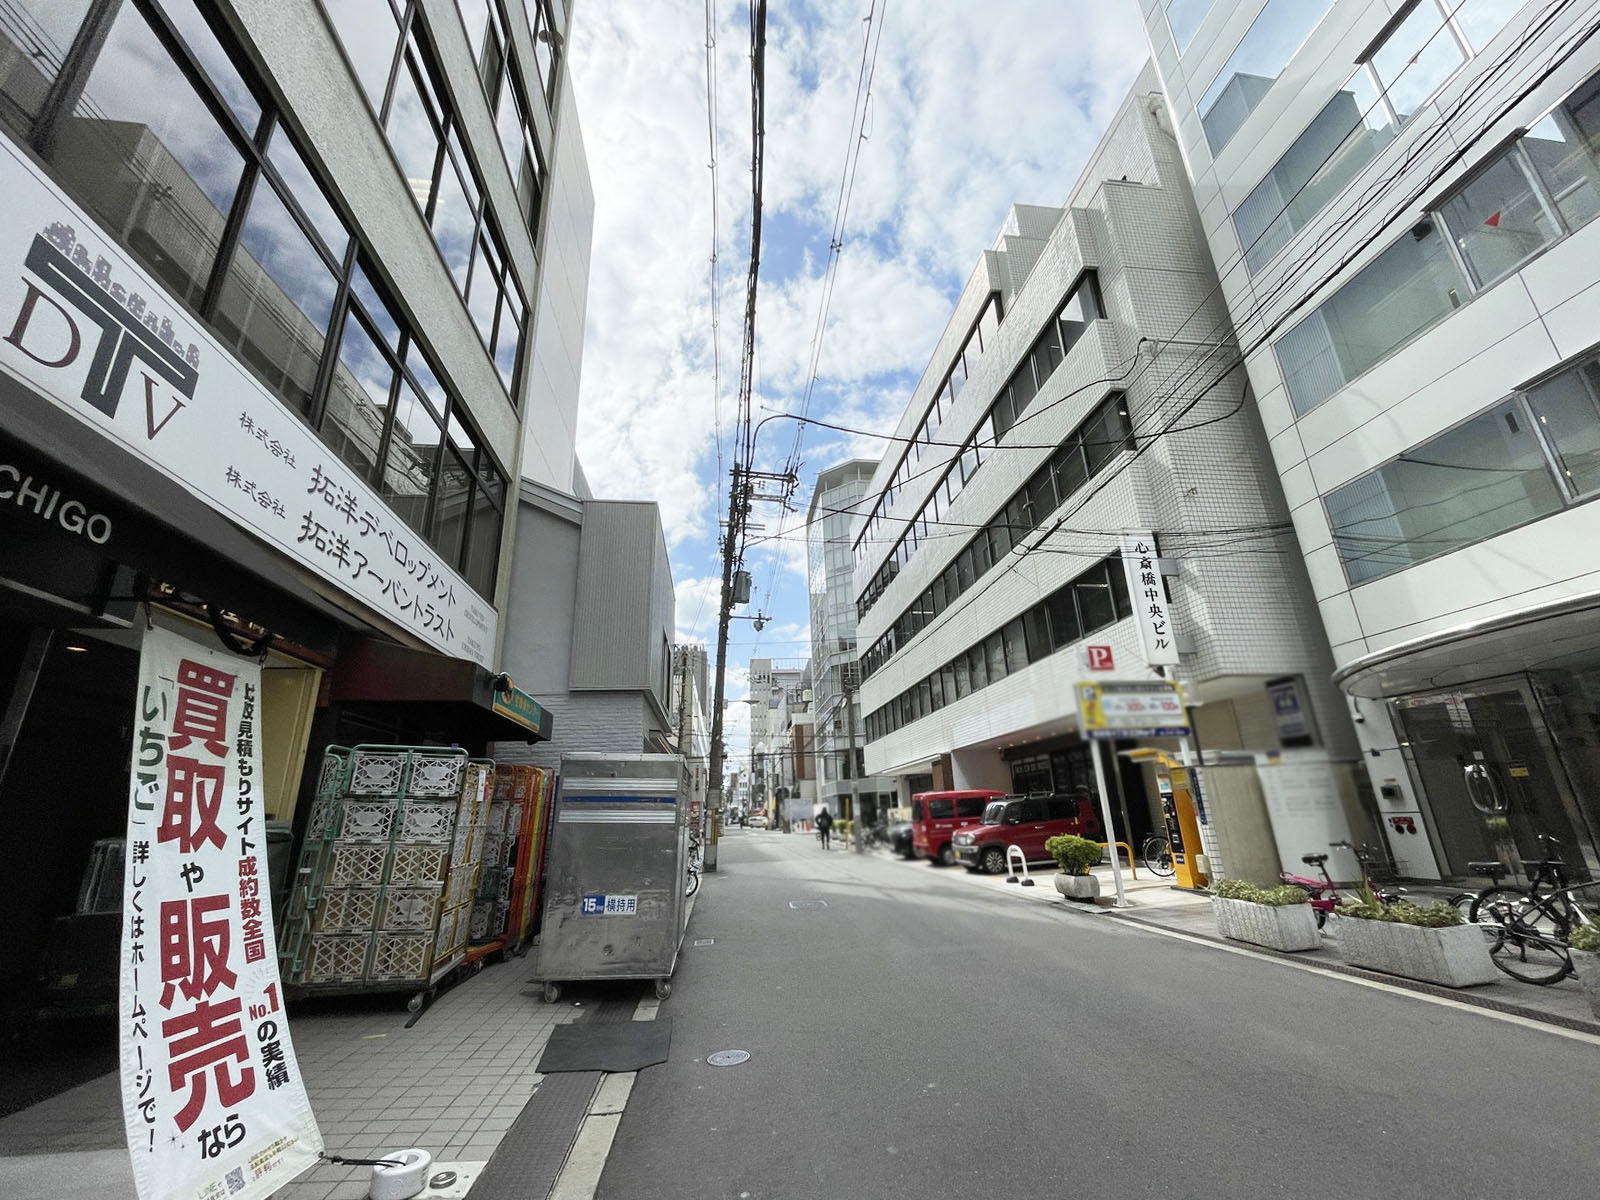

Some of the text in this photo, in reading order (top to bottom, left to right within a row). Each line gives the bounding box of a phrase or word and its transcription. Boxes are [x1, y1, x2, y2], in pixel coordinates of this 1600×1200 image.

[225, 465, 454, 642] 株式会社 拓洋アーバントラスト
[240, 411, 456, 607] 株式会社 拓洋デベロップメント
[1135, 541, 1169, 650] 心斎橋中央ビル
[1089, 647, 1107, 668] P
[607, 898, 636, 912] 横持用
